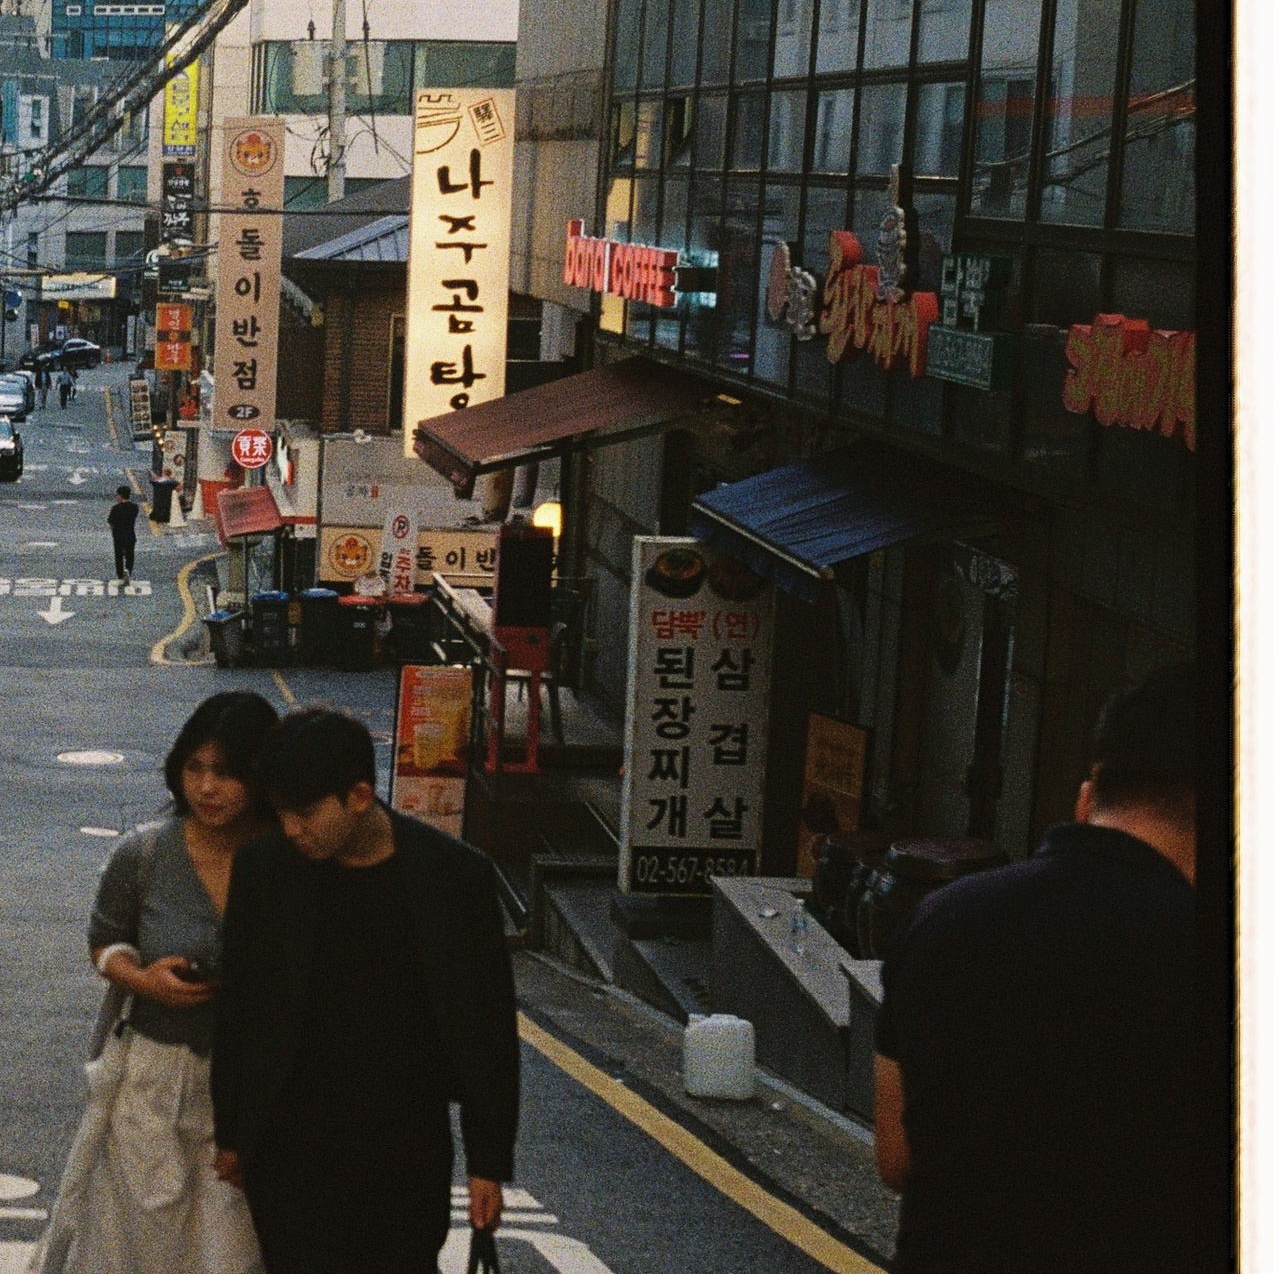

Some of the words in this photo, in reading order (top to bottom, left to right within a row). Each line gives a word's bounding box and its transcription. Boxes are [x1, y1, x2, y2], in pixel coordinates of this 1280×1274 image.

[231, 190, 266, 392] 호돌이반점
[429, 147, 494, 410] 나주곰탕
[234, 404, 254, 419] 2F
[395, 554, 412, 590] 주차
[646, 646, 696, 838] 된장찌개
[703, 648, 756, 840] 삼겹살
